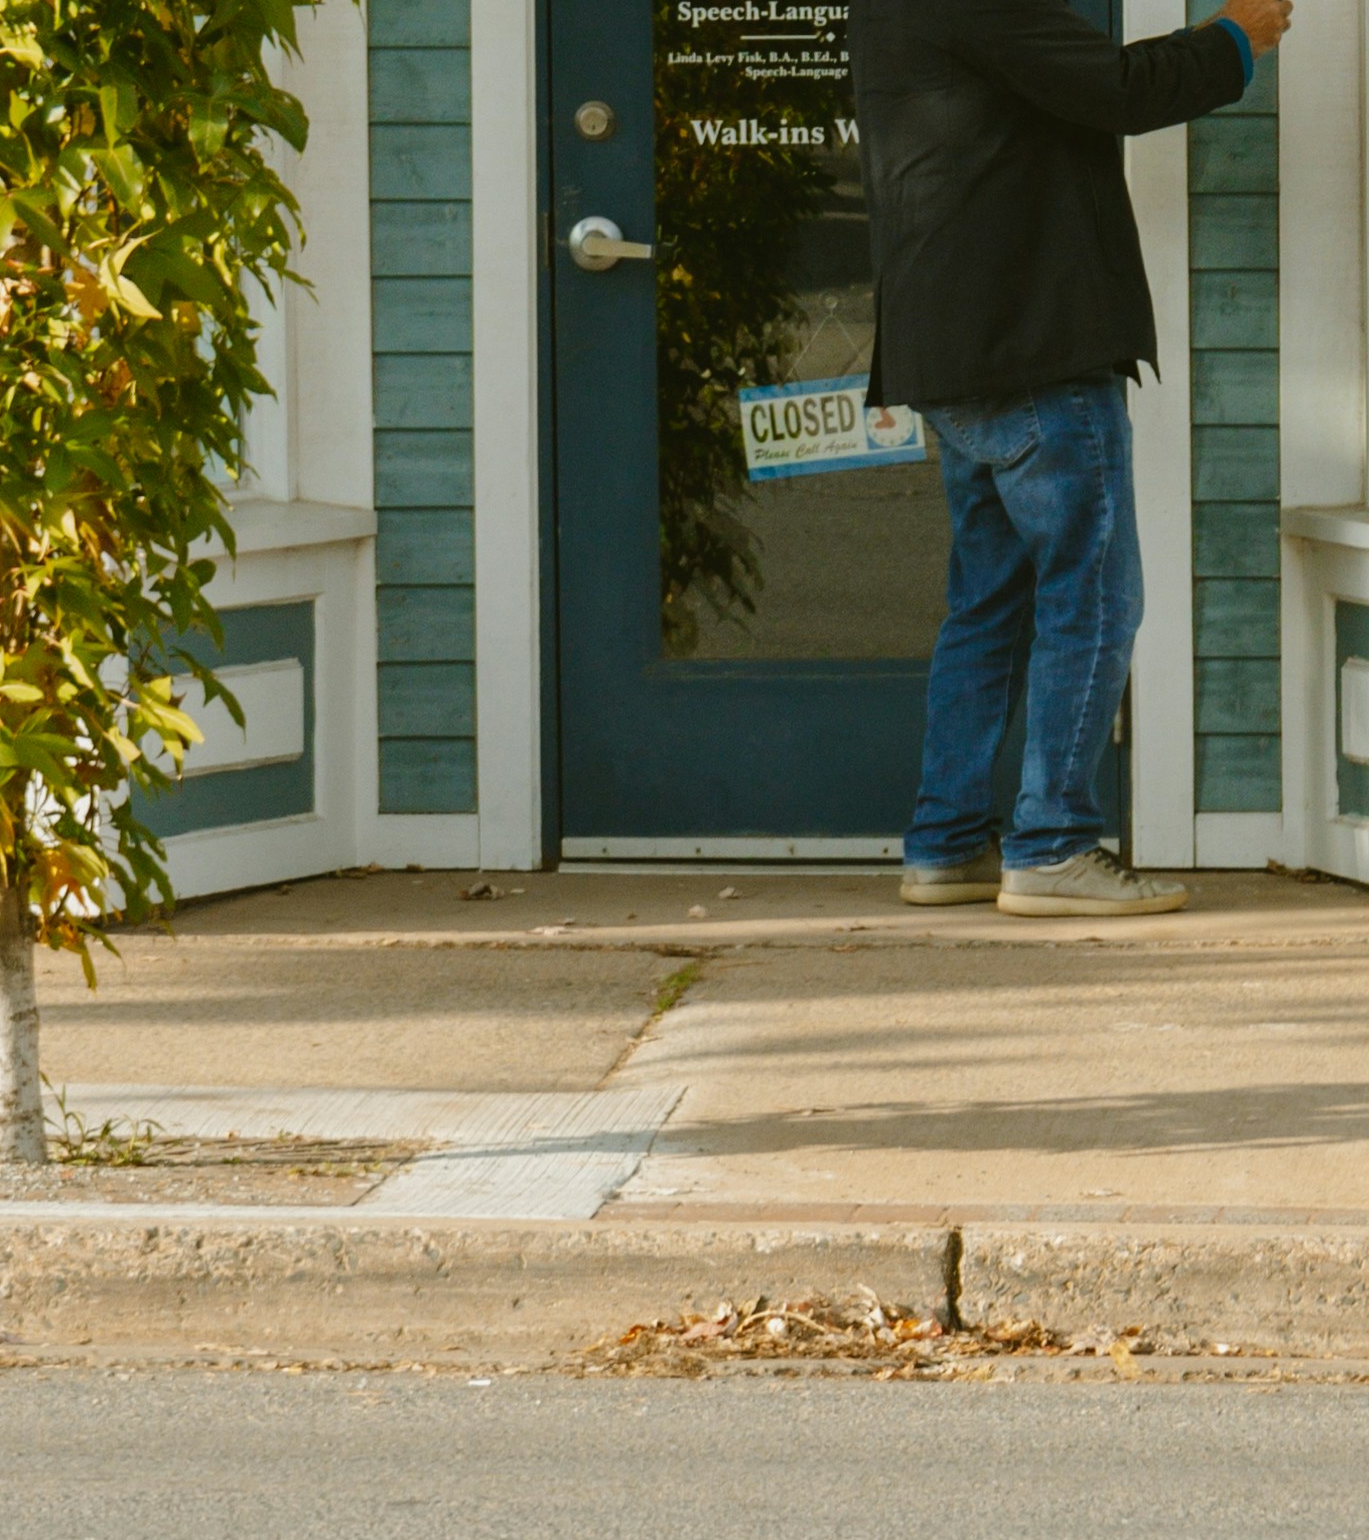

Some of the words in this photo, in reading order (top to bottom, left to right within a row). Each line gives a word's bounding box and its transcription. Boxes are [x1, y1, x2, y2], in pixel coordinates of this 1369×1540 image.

[677, 1, 848, 28] Speech-Langu
[668, 53, 702, 63] Linda
[691, 118, 824, 145] Walk-ins
[750, 394, 856, 443] CLOSED
[754, 448, 791, 461] Please
[795, 442, 820, 458] Call
[823, 439, 858, 455] Again
